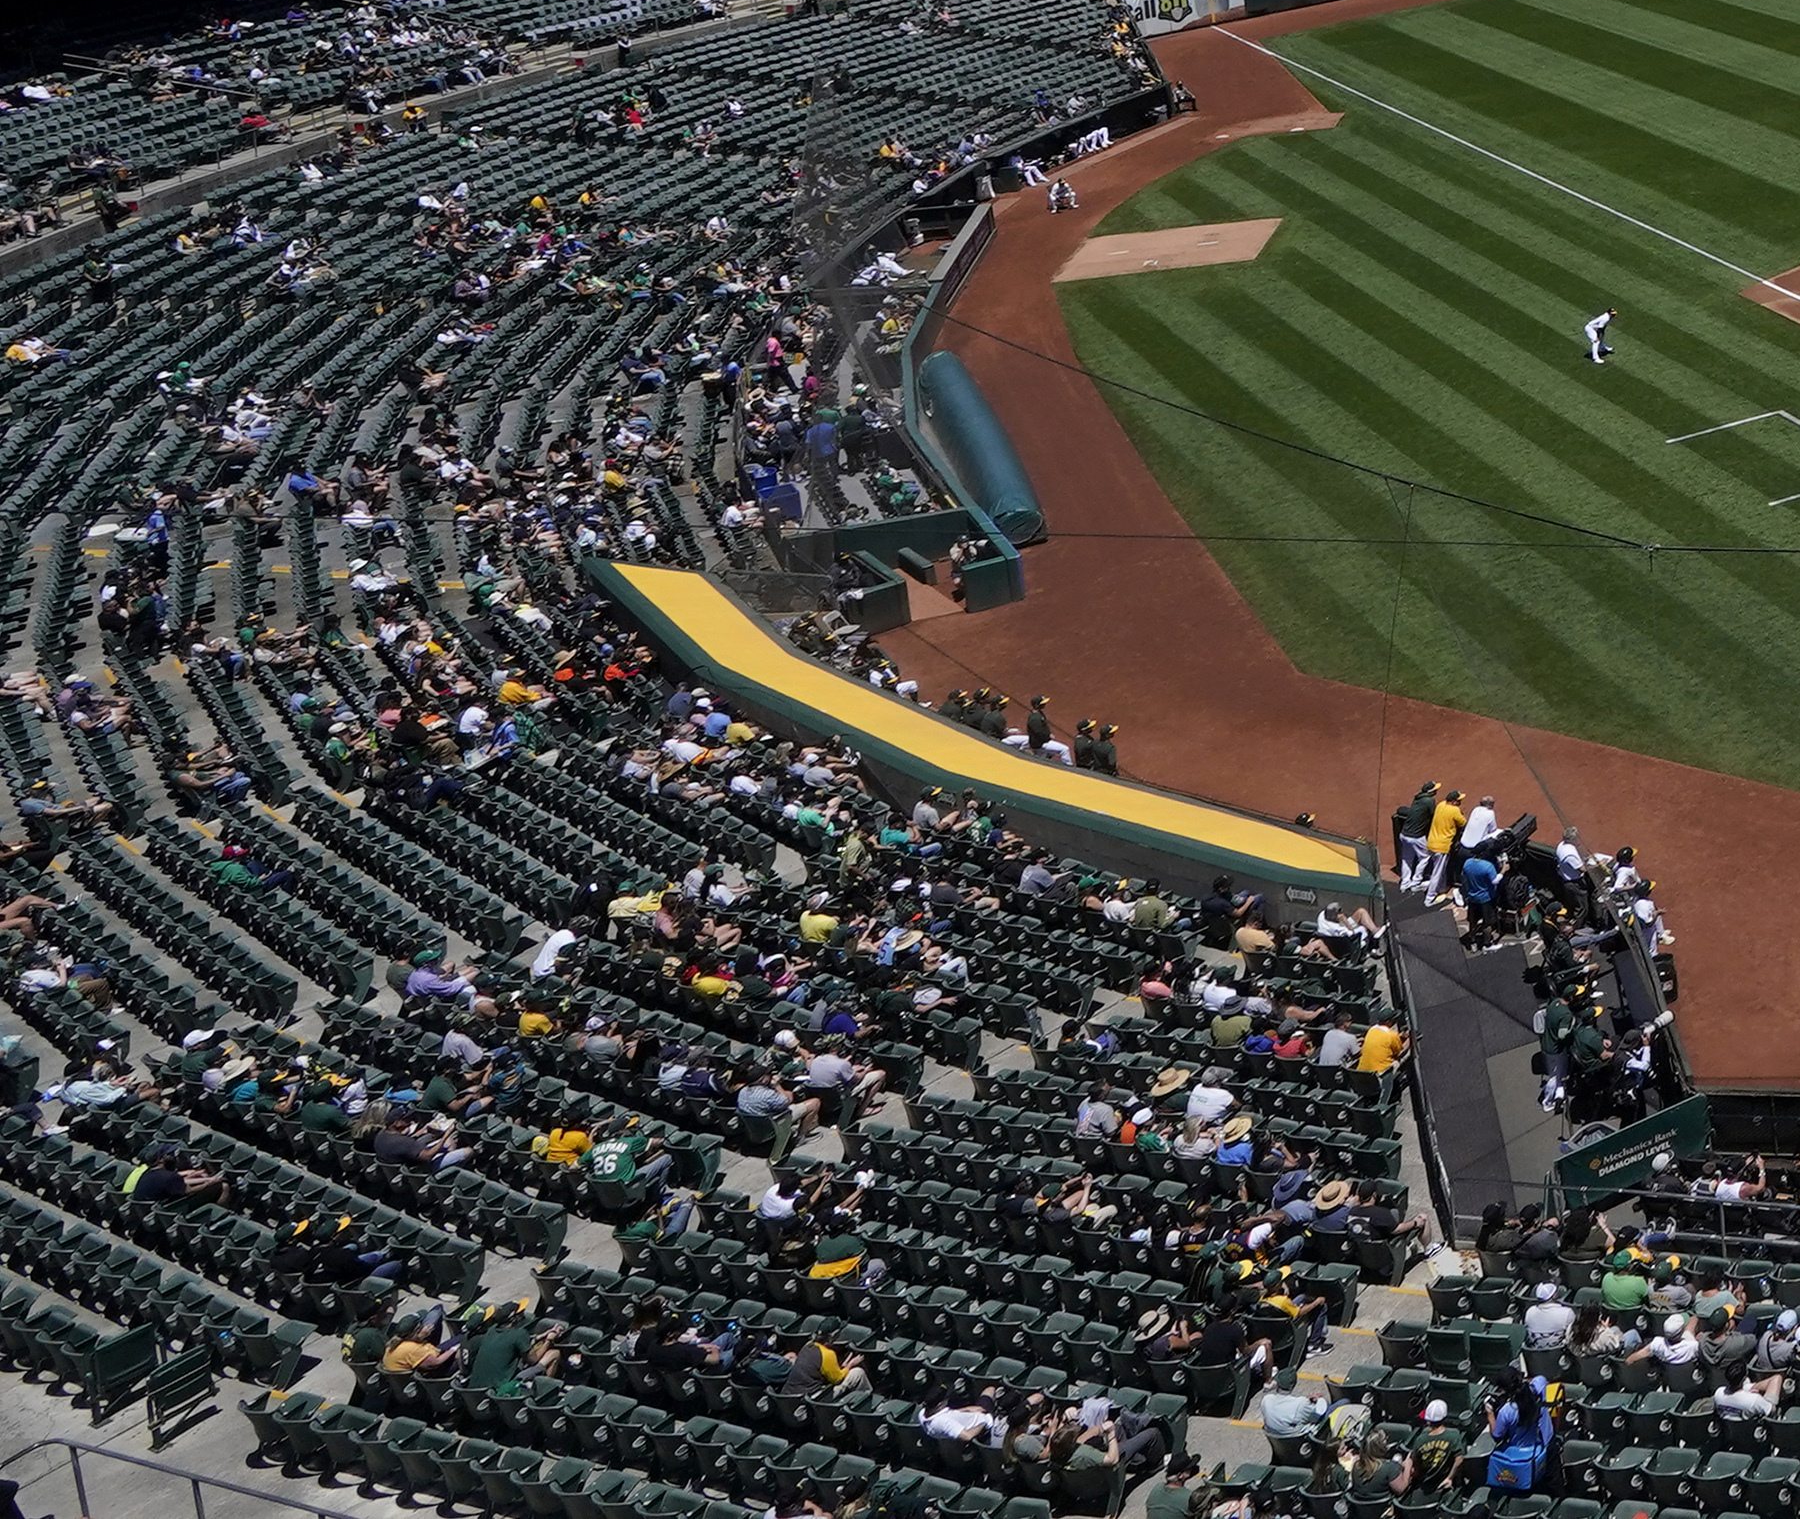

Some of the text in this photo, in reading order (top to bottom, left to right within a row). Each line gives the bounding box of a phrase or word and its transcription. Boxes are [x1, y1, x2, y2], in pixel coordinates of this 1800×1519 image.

[594, 1153, 618, 1175] 26
[1598, 1141, 1671, 1178] DIAMOND LEVEL
[1603, 1128, 1679, 1165] Mechanics Bank
